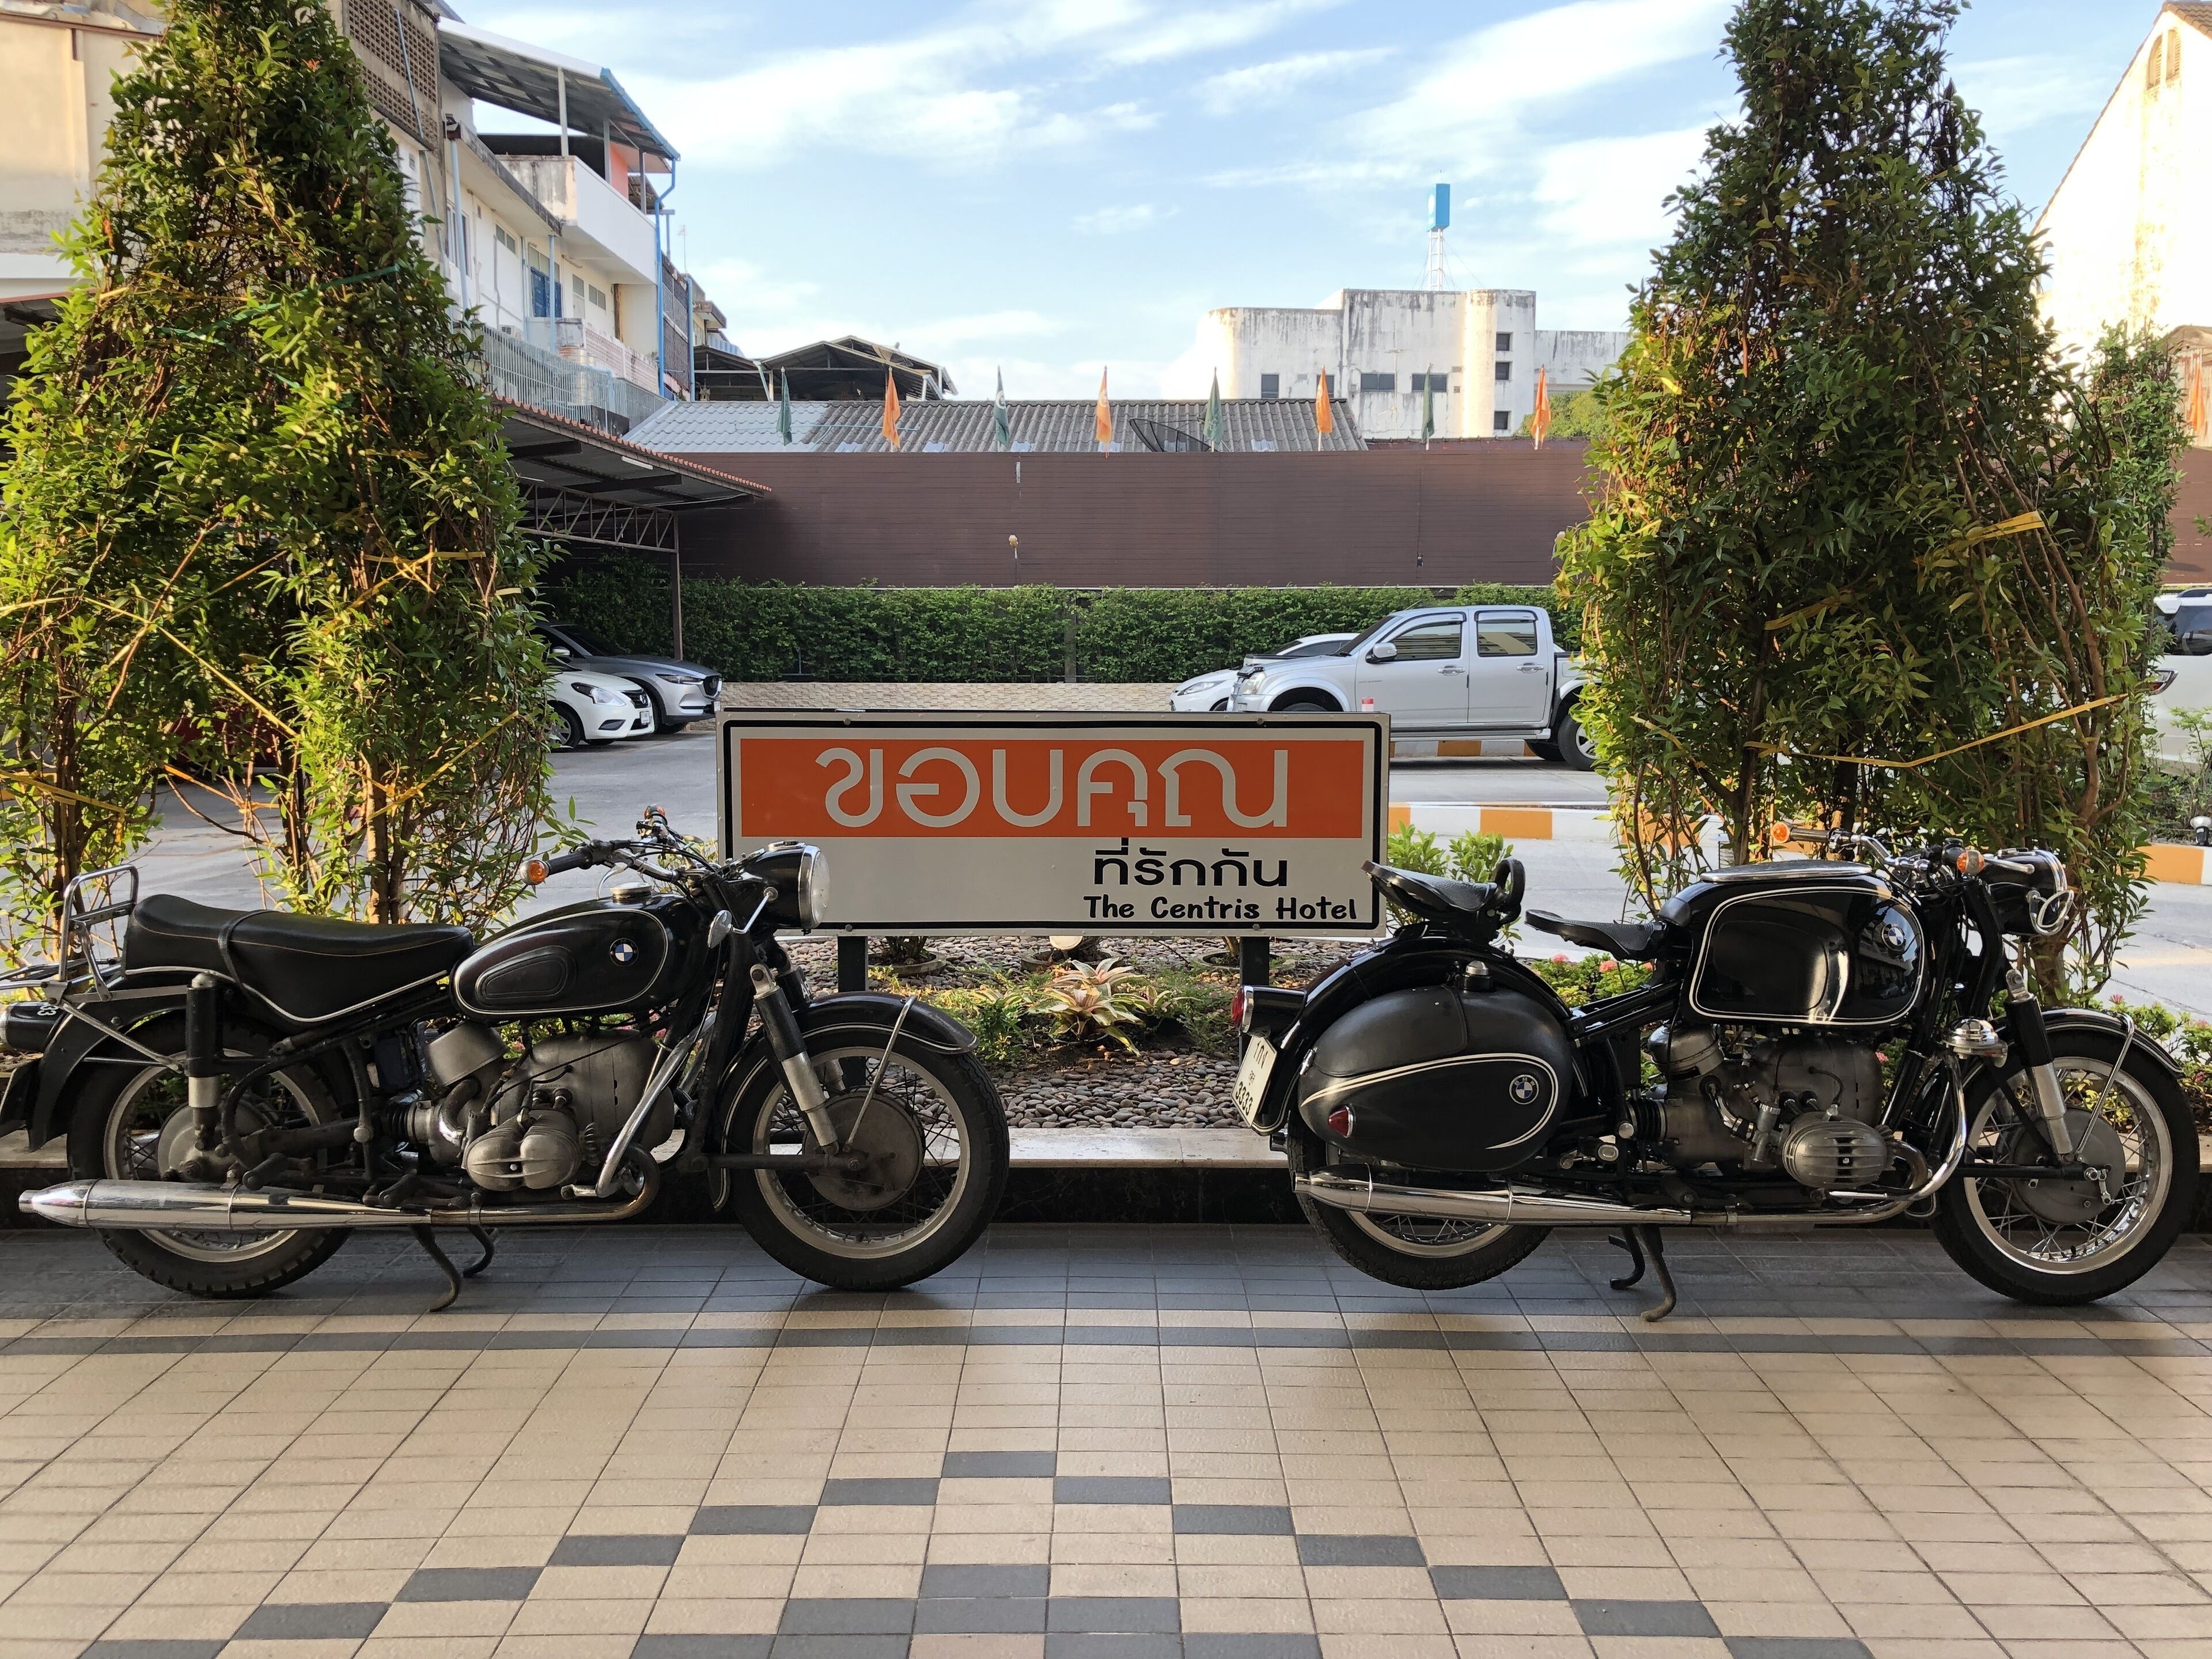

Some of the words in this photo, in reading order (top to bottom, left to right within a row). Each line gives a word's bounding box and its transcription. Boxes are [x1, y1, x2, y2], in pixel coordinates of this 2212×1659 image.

[816, 747, 1287, 828] ขอบคุณ
[1094, 837, 1287, 887] ที่รักกัน
[1084, 894, 1135, 918] The
[1151, 896, 1260, 919] Centris
[1276, 896, 1357, 920] Hotel
[1236, 1081, 1253, 1115] 3333
